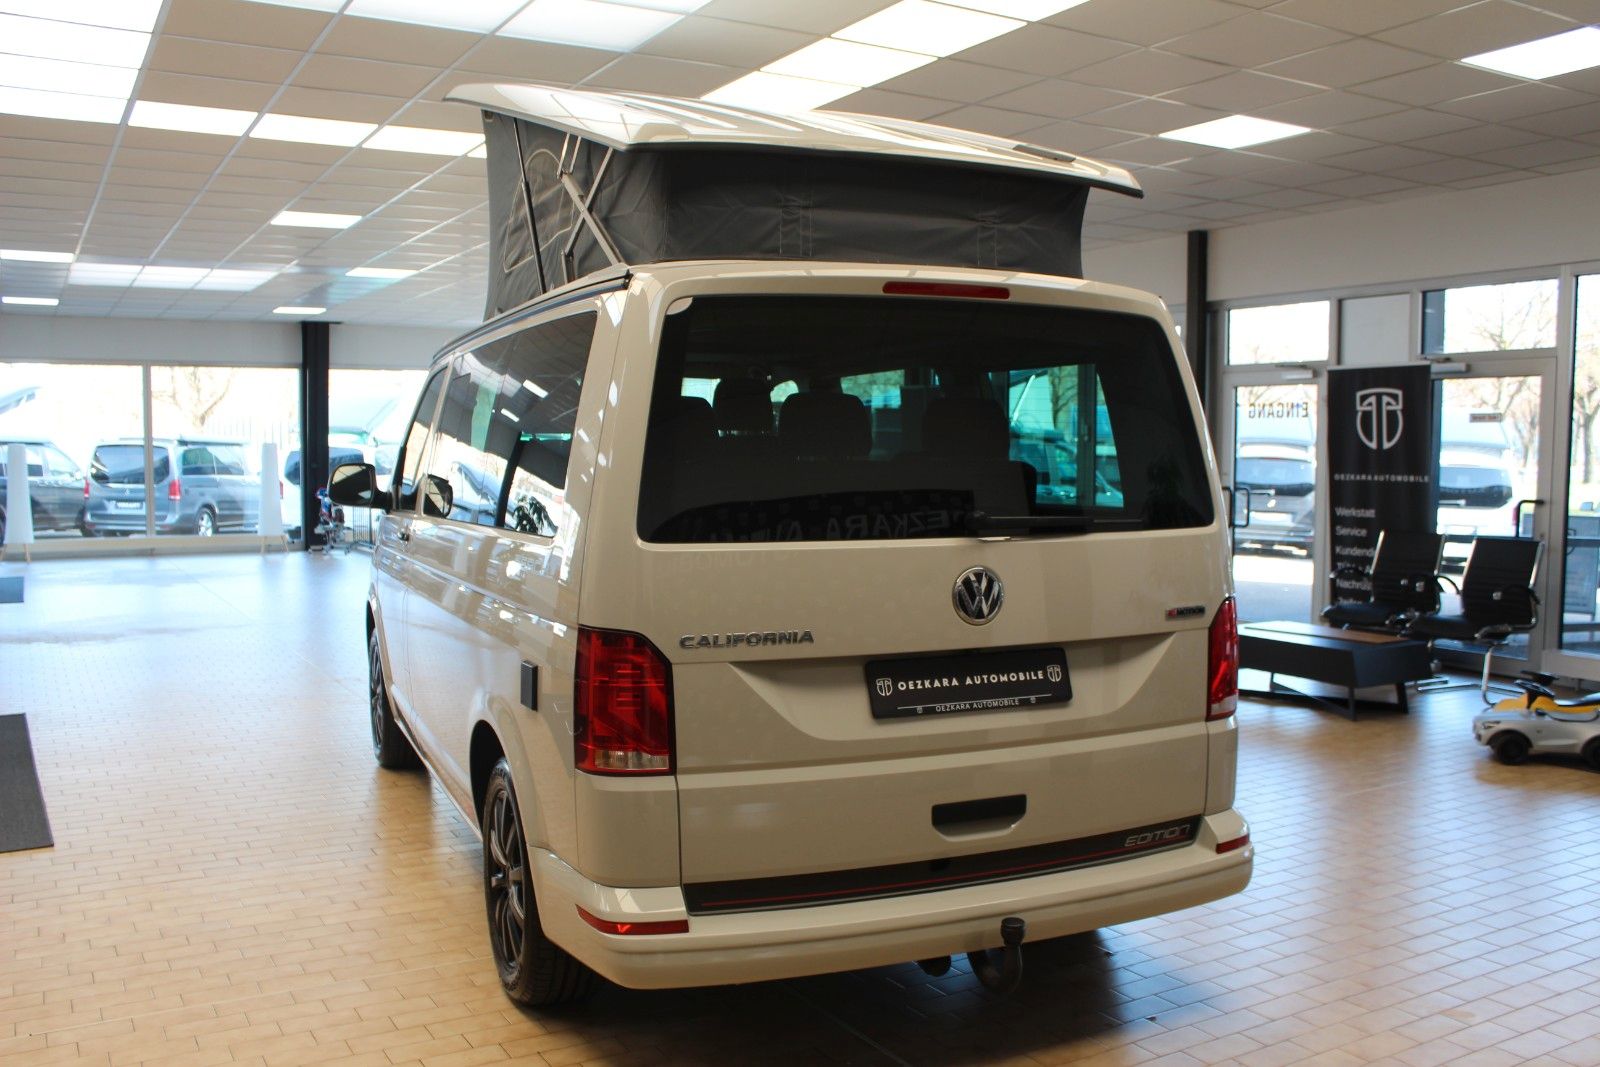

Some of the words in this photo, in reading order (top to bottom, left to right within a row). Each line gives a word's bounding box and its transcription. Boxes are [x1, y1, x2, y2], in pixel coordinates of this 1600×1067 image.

[1335, 507, 1376, 518] Werkstatt
[1335, 525, 1368, 537] Service
[679, 630, 815, 650] CALIFORNIA
[897, 677, 959, 691] OEZKARA
[965, 670, 1045, 686] AUTOMOBILE
[935, 702, 971, 713] OEZKARA
[973, 698, 1020, 710] AUTOMOBILE
[1124, 824, 1191, 847] EDITION
